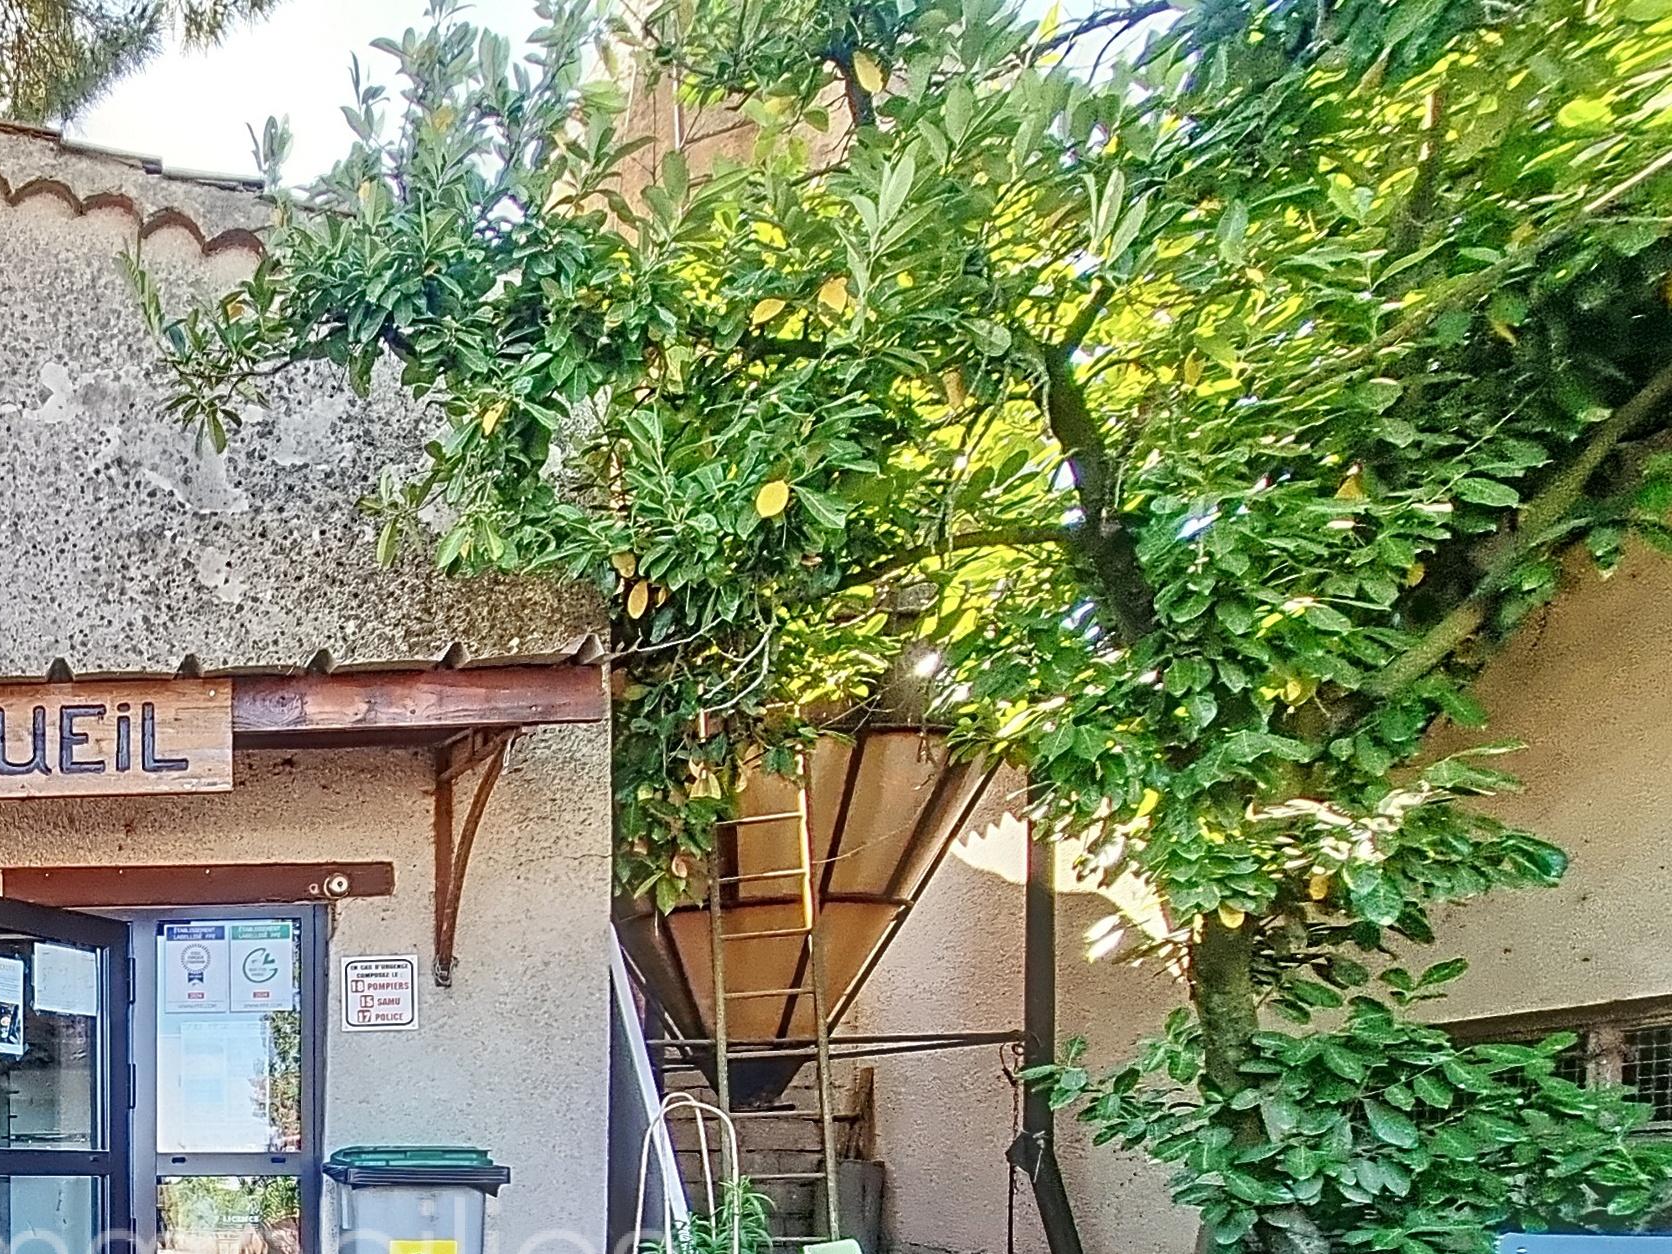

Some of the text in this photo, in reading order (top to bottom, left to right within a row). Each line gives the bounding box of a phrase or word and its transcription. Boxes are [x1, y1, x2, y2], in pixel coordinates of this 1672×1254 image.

[351, 981, 409, 992] 18 POMPIERS
[360, 996, 400, 1007] 15 SAMU
[358, 1011, 403, 1022] 17 POLICE
